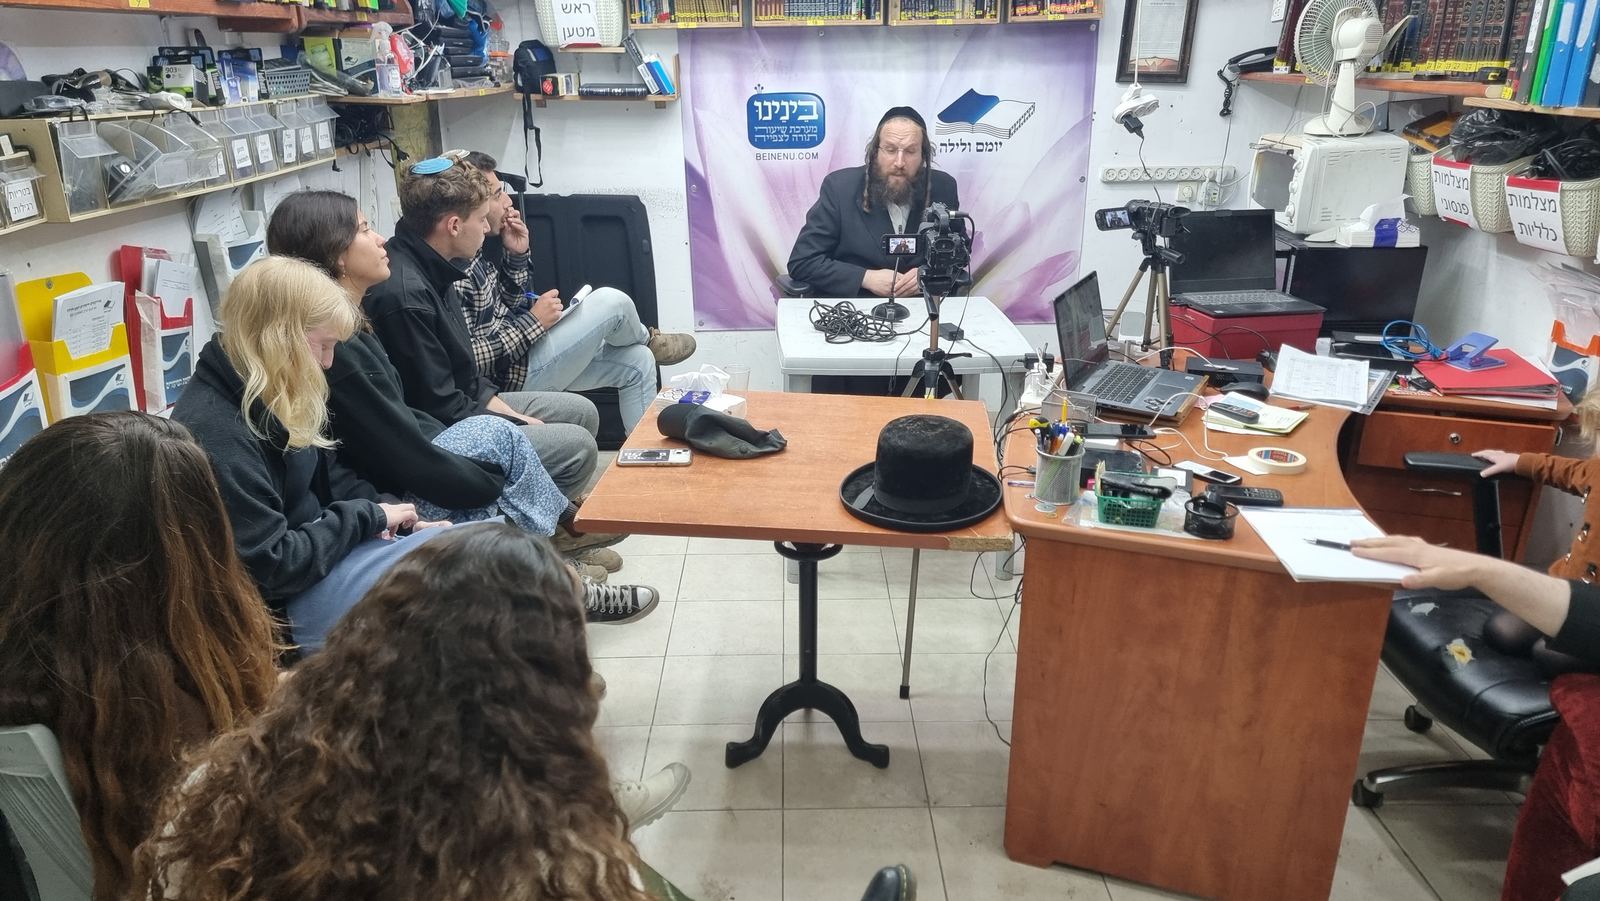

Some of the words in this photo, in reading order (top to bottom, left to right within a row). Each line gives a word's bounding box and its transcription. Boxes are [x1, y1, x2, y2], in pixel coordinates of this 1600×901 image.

[561, 3, 591, 14] ראש
[562, 26, 595, 41] מטען
[754, 125, 788, 134] שיעורי
[789, 125, 818, 134] מערכת
[754, 133, 790, 142] לצפייה
[791, 134, 818, 142] תורה
[939, 138, 972, 153] ולילה
[975, 141, 1003, 152] יומם
[755, 152, 819, 161] BEINENU.COM
[1434, 170, 1469, 190] מצלמות
[8, 187, 31, 200] בטריות
[13, 202, 34, 215] רגילות
[1440, 198, 1470, 215] פנסוני
[1508, 192, 1557, 213] מצלמות
[1517, 221, 1558, 241] כלליות
